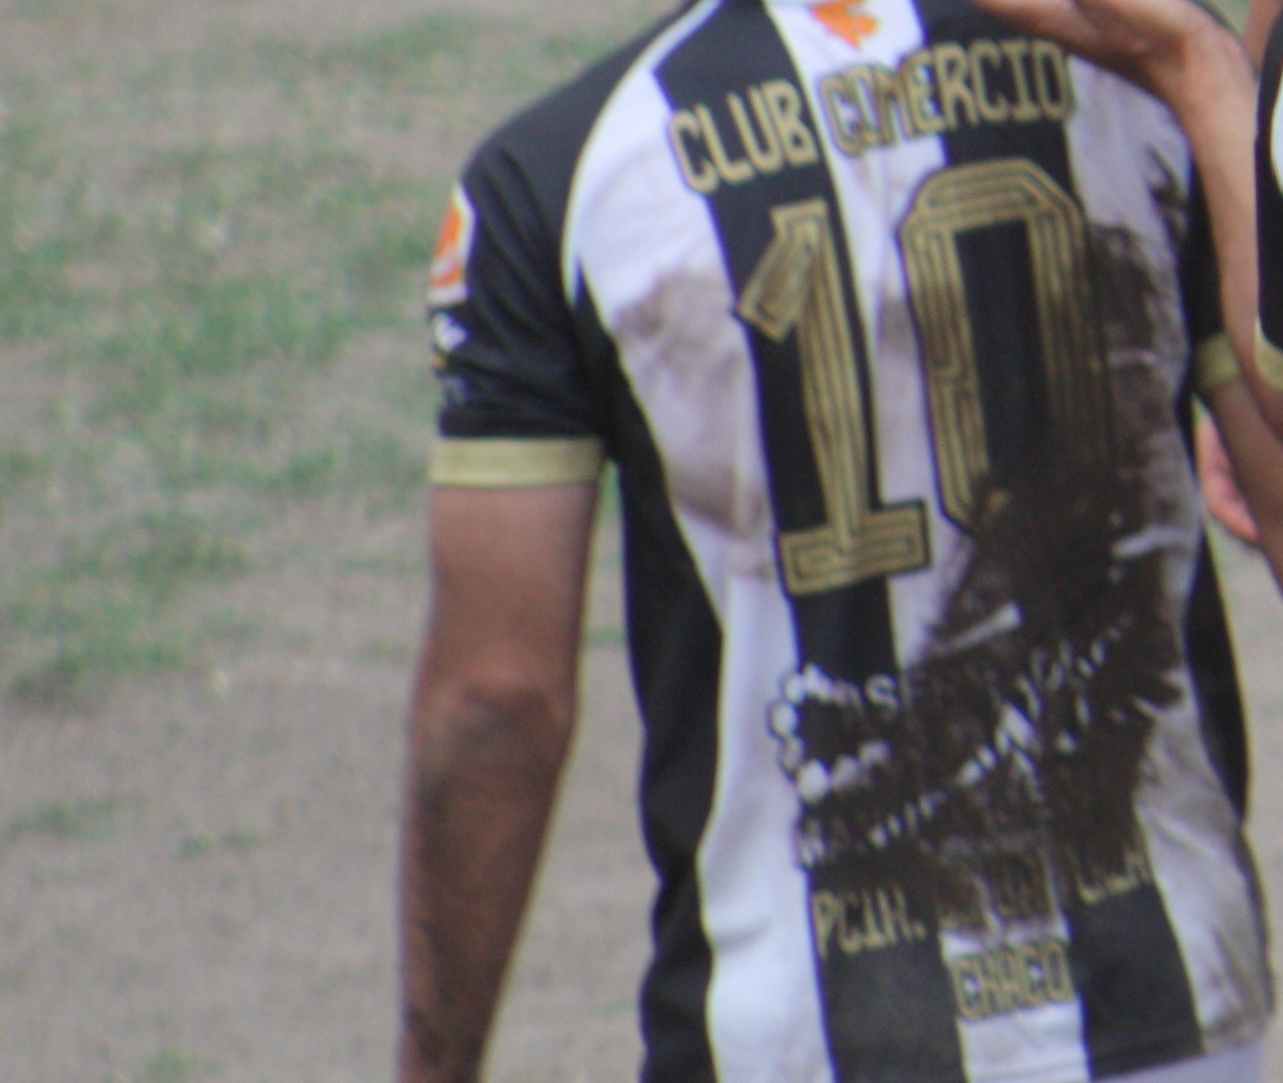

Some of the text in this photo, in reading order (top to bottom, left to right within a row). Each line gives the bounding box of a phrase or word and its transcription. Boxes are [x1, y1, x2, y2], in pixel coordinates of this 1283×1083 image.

[668, 38, 1076, 195] CLUB COMERCIO
[733, 156, 1115, 596] 10
[951, 935, 1074, 1021] CHACO
